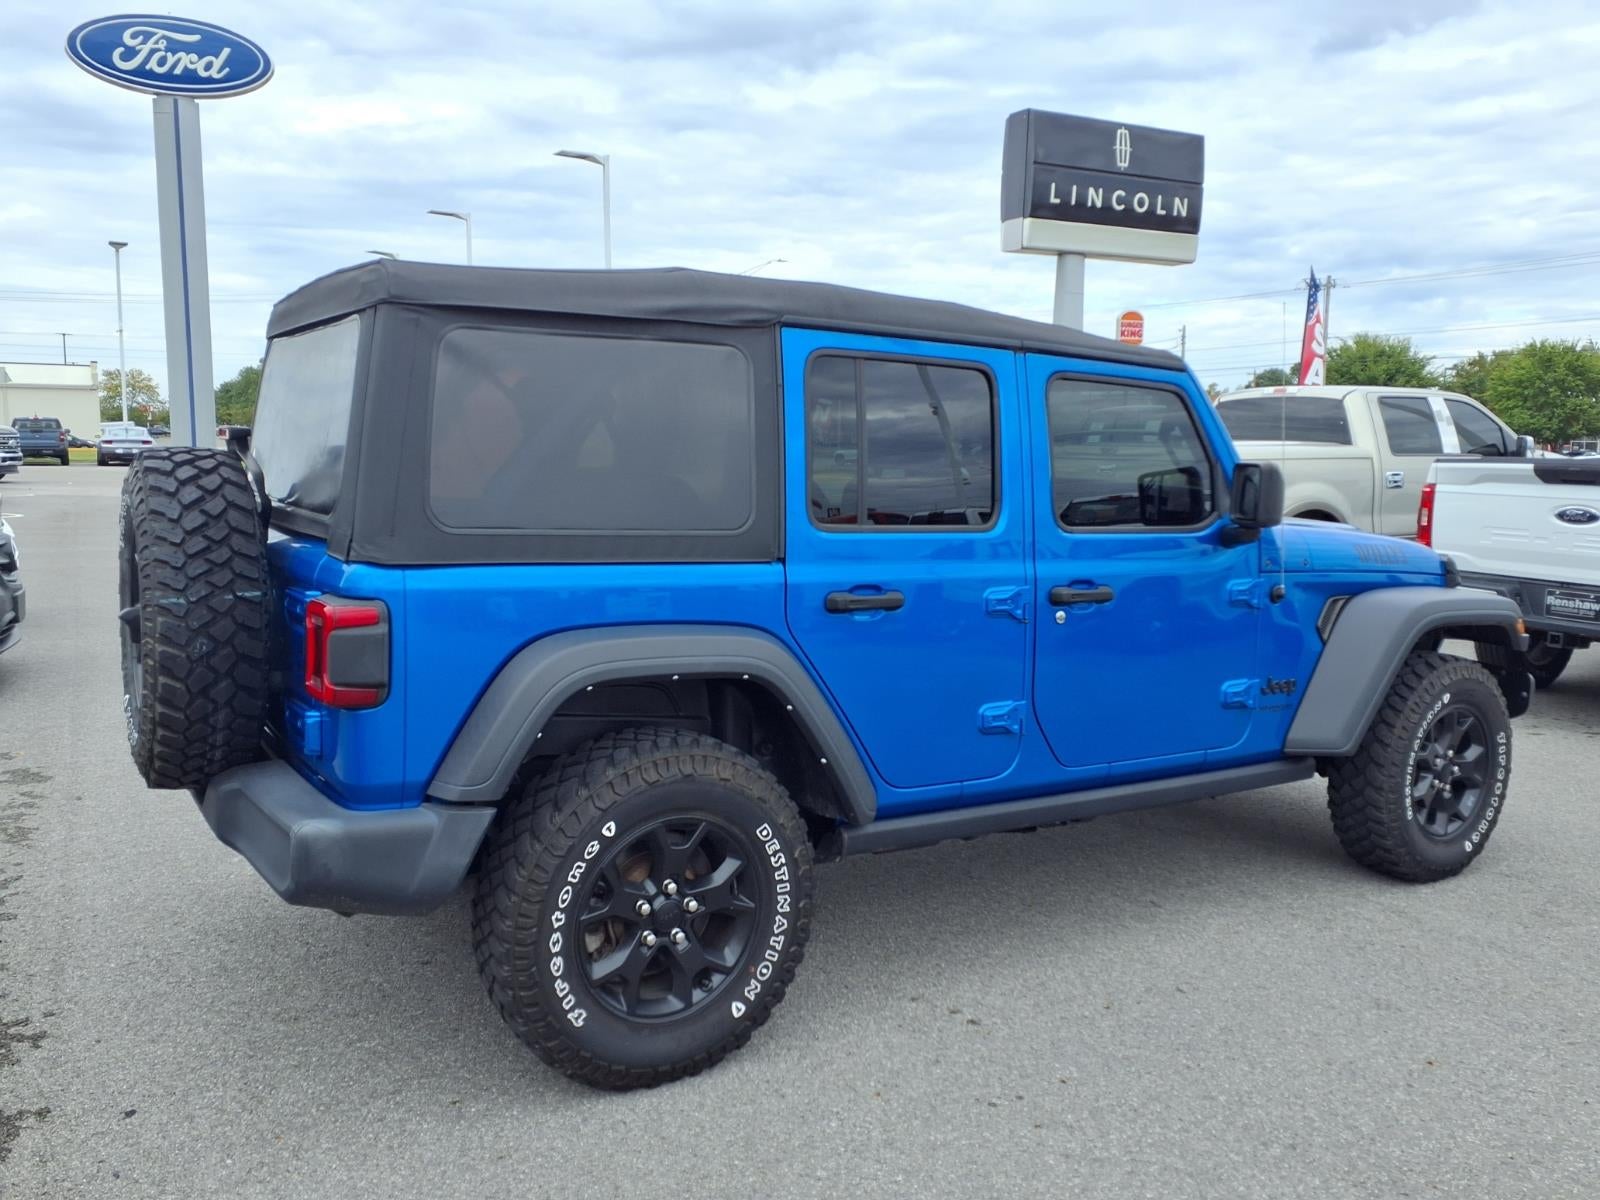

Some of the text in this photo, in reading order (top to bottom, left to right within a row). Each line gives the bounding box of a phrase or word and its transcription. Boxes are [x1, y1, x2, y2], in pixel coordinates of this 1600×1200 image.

[112, 26, 231, 79] Ford
[1049, 182, 1188, 217] LINCOLN
[1120, 328, 1143, 338] KING
[1562, 508, 1591, 521] Ford
[1546, 595, 1600, 612] Renshaw
[1260, 676, 1296, 697] Jeep
[744, 822, 791, 1001] DESTINATION
